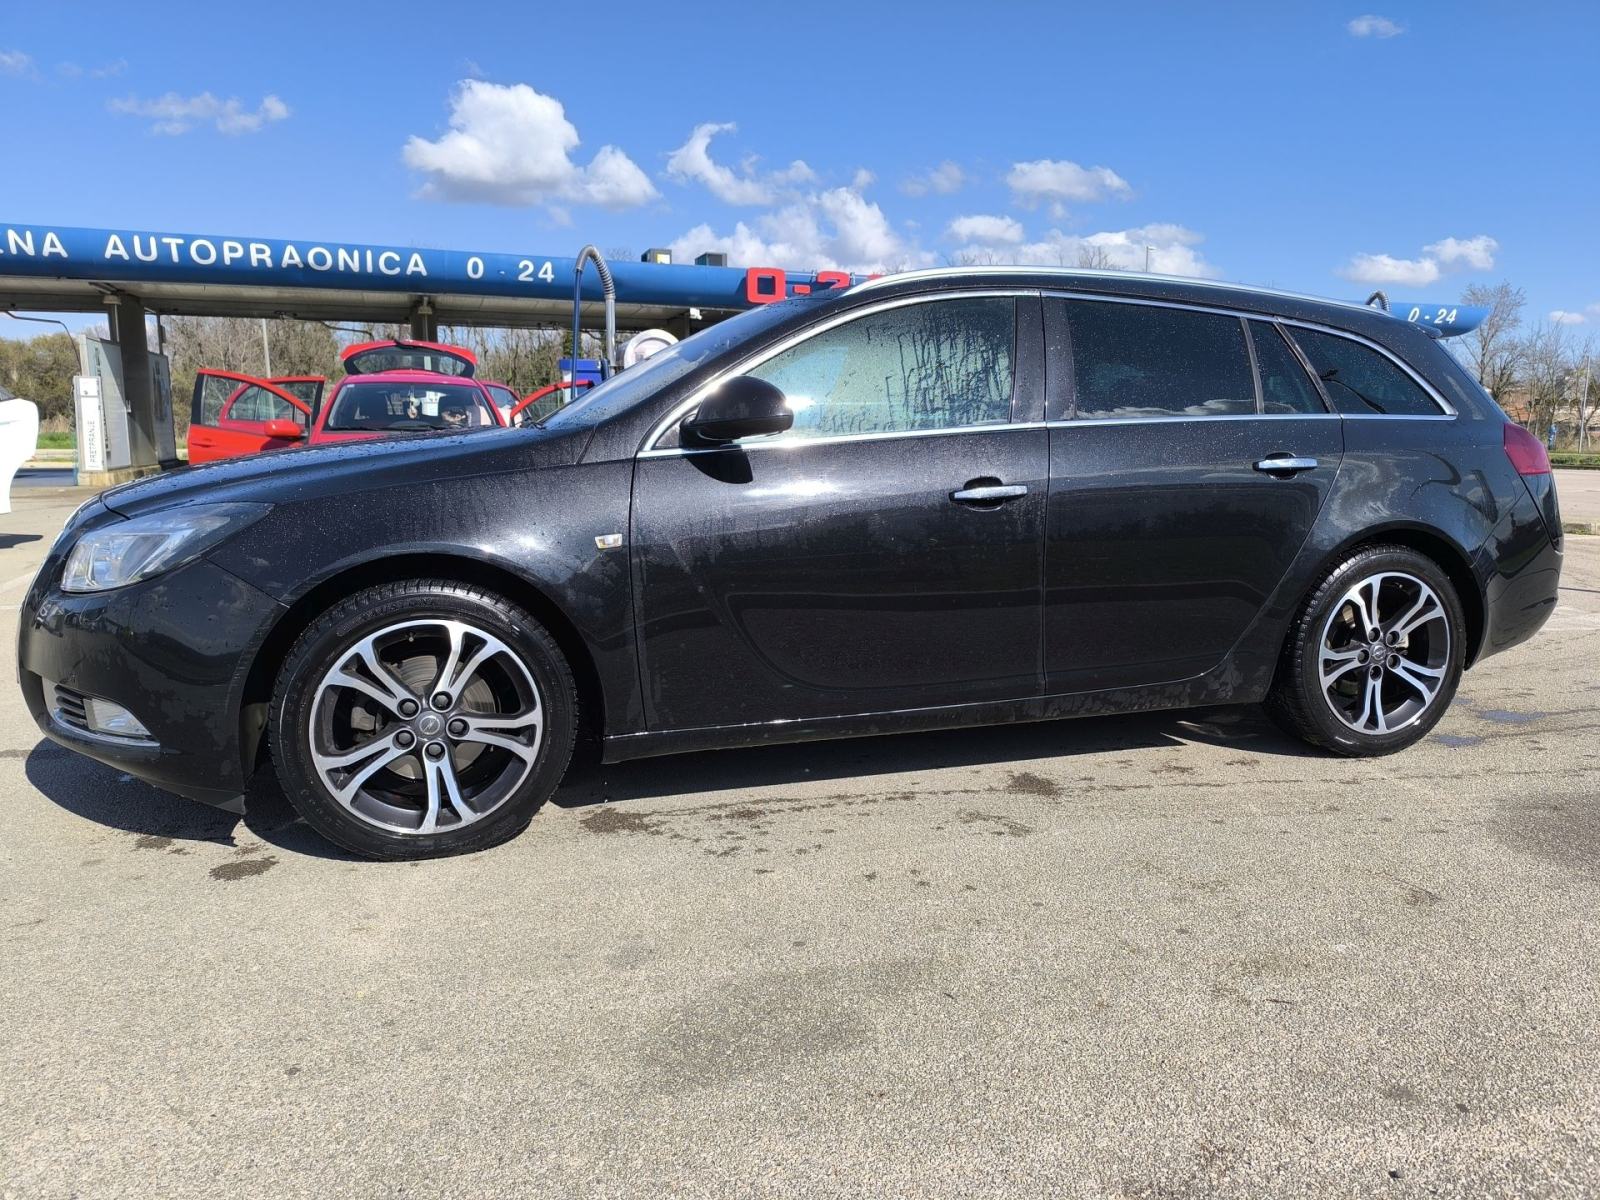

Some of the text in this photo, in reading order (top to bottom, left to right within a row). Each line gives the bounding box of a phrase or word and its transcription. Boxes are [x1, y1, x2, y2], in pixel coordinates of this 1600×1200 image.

[0, 228, 69, 258] NA
[104, 233, 428, 277] AUTOPRAONICA
[466, 256, 484, 279] 0
[518, 259, 555, 283] 24
